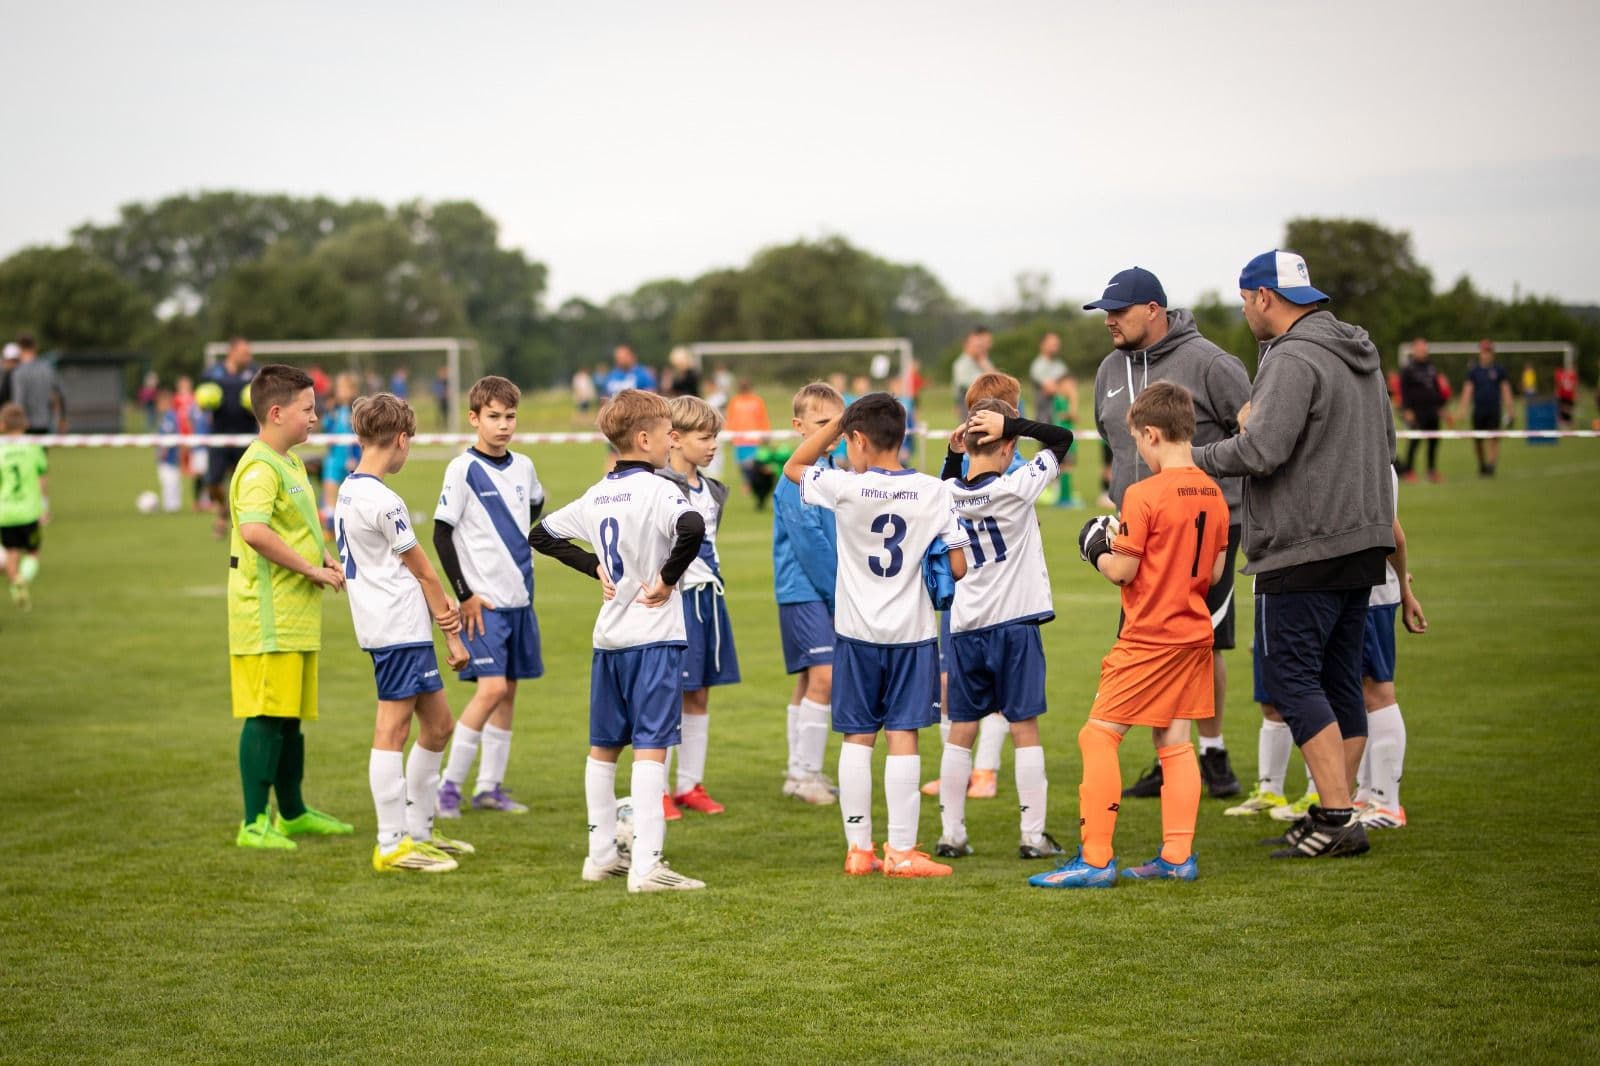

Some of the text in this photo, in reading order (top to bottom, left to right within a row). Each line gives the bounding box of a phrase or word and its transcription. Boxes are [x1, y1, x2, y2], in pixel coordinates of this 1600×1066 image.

[868, 513, 907, 578] 3
[960, 515, 1007, 569] 11
[1191, 511, 1206, 577] 1
